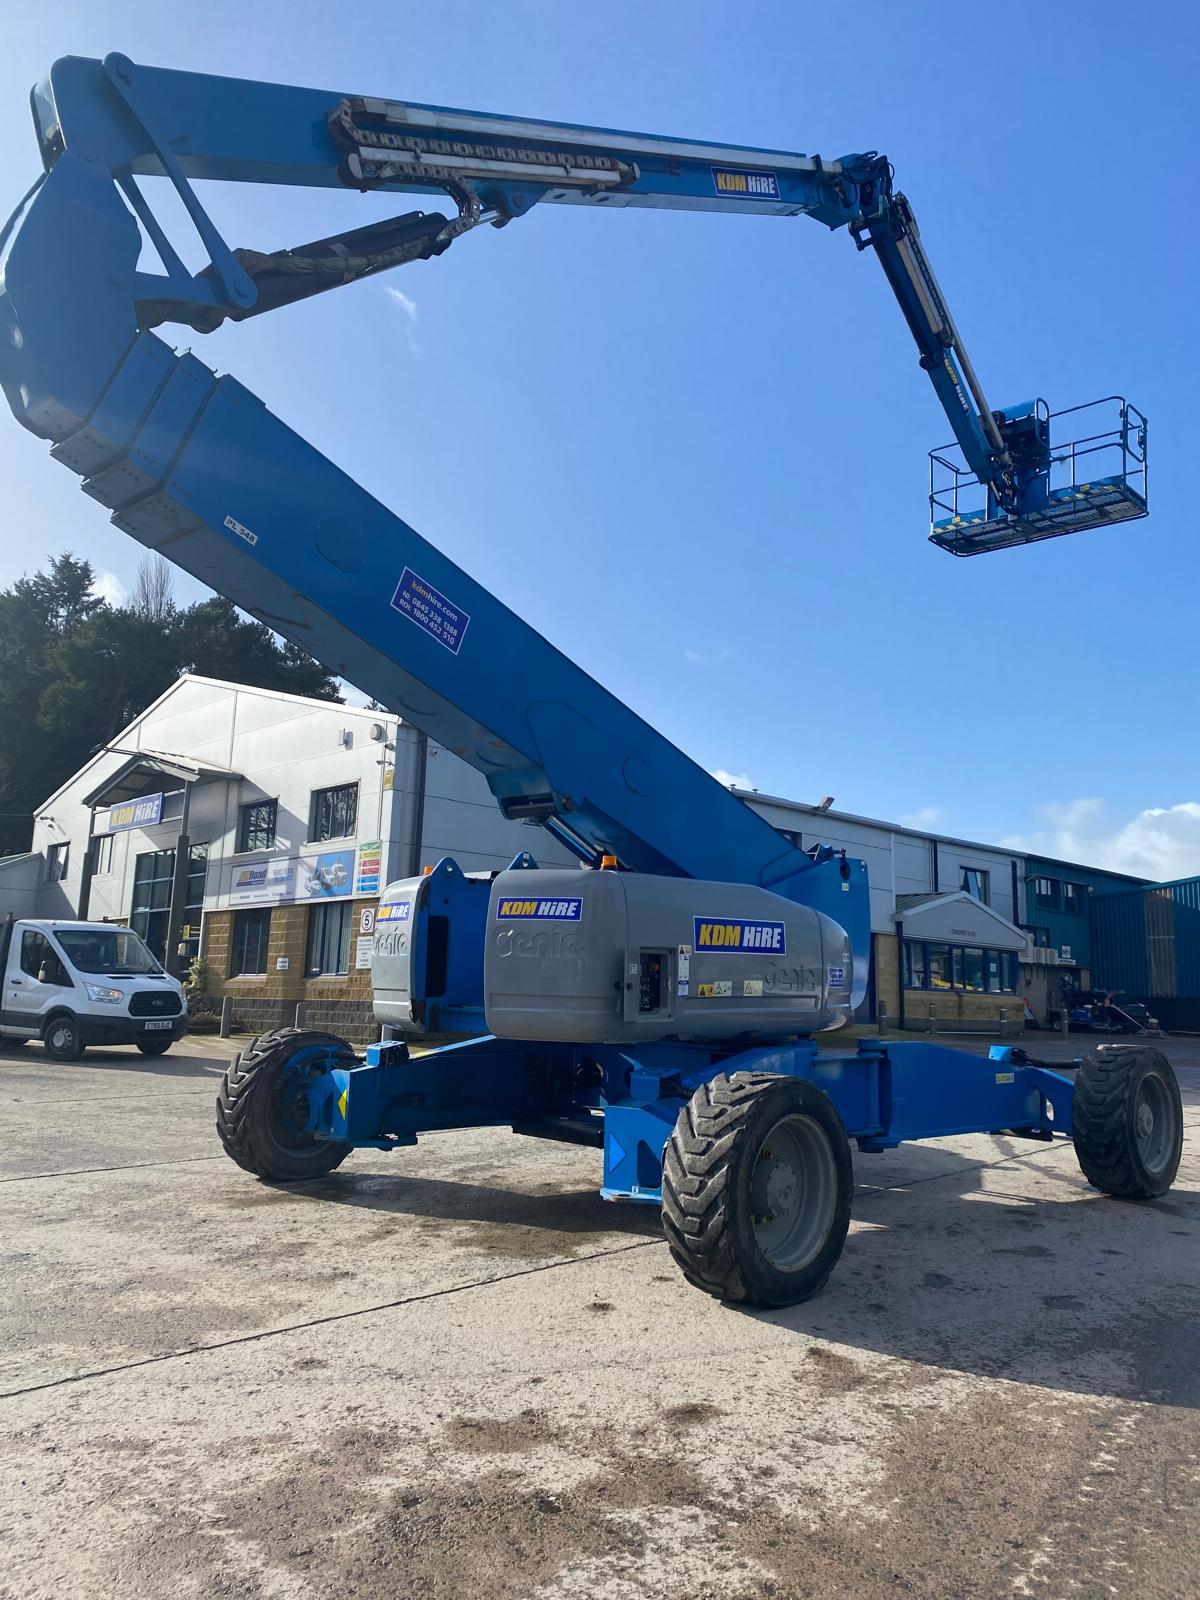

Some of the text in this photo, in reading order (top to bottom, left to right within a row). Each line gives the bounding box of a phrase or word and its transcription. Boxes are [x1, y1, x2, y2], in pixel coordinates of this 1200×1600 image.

[717, 173, 776, 194] KDM HiRE
[239, 528, 255, 542] 548
[411, 580, 458, 622] kdmhire.com
[412, 597, 430, 614] 0845
[428, 610, 442, 624] 338
[413, 608, 429, 624] 1800
[429, 621, 442, 635] 452
[442, 631, 455, 645] 510
[111, 800, 160, 826] KDM HiRE
[364, 914, 370, 926] 5
[500, 901, 579, 916] KDM HiRE
[698, 923, 782, 949] KDM HiRE
